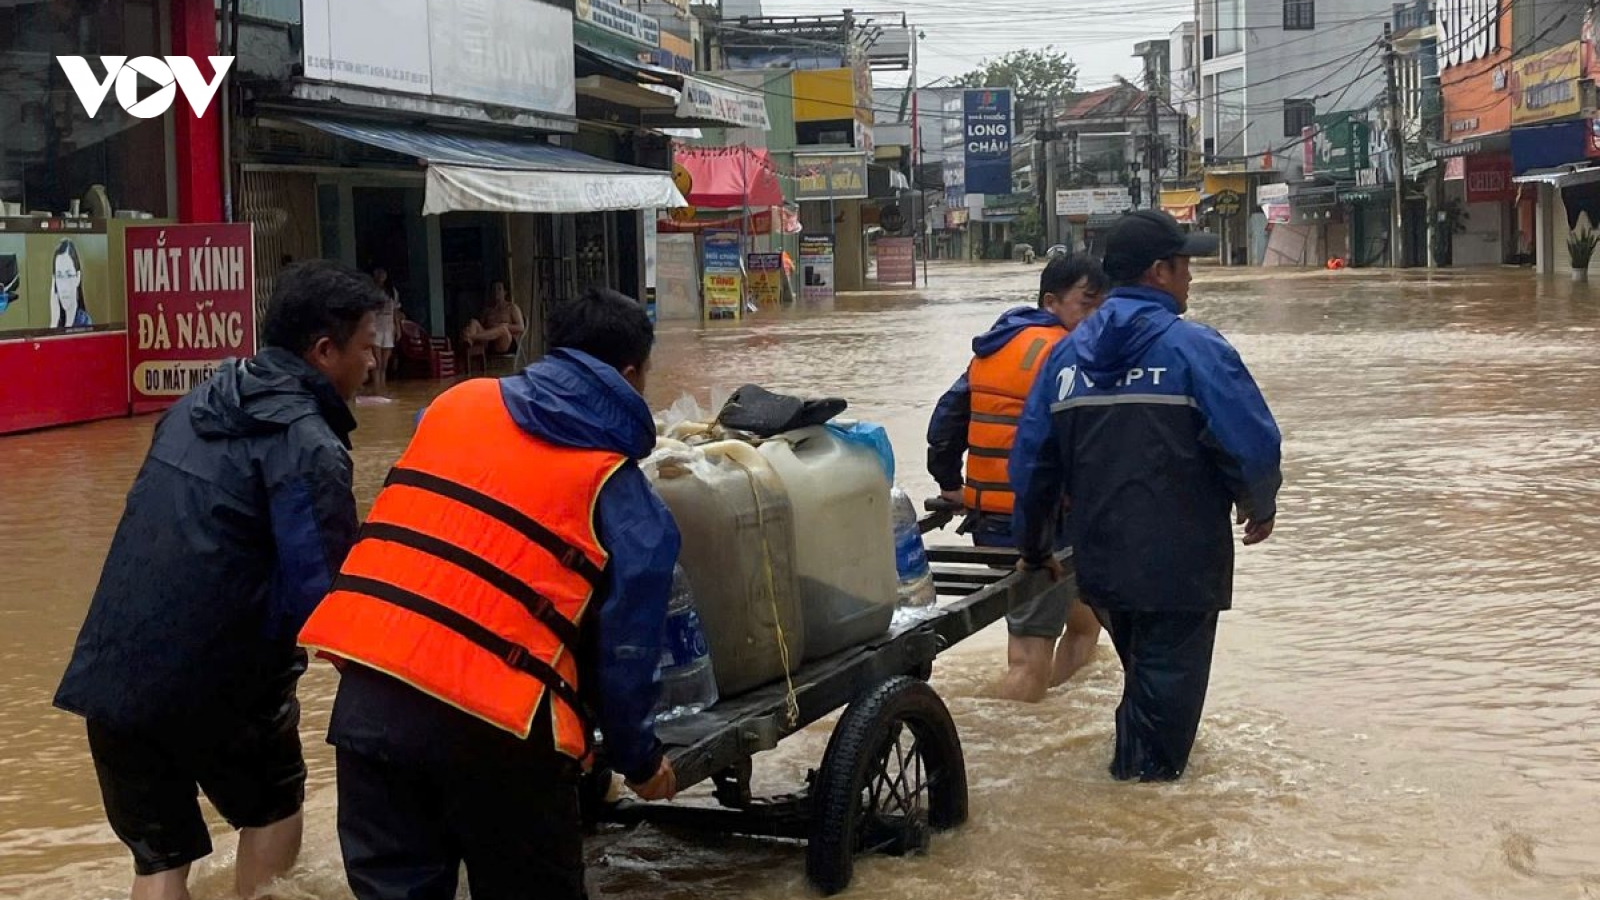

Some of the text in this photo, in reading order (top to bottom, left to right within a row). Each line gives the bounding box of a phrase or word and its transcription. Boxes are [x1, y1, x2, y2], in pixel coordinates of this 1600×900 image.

[967, 124, 1007, 136] LONG
[968, 138, 1009, 153] CHÂU
[133, 230, 244, 292] MẮT KÍNH
[138, 300, 244, 349] ĐÀ NẴNG
[145, 368, 160, 391] ĐO
[163, 363, 186, 391] MẮT
